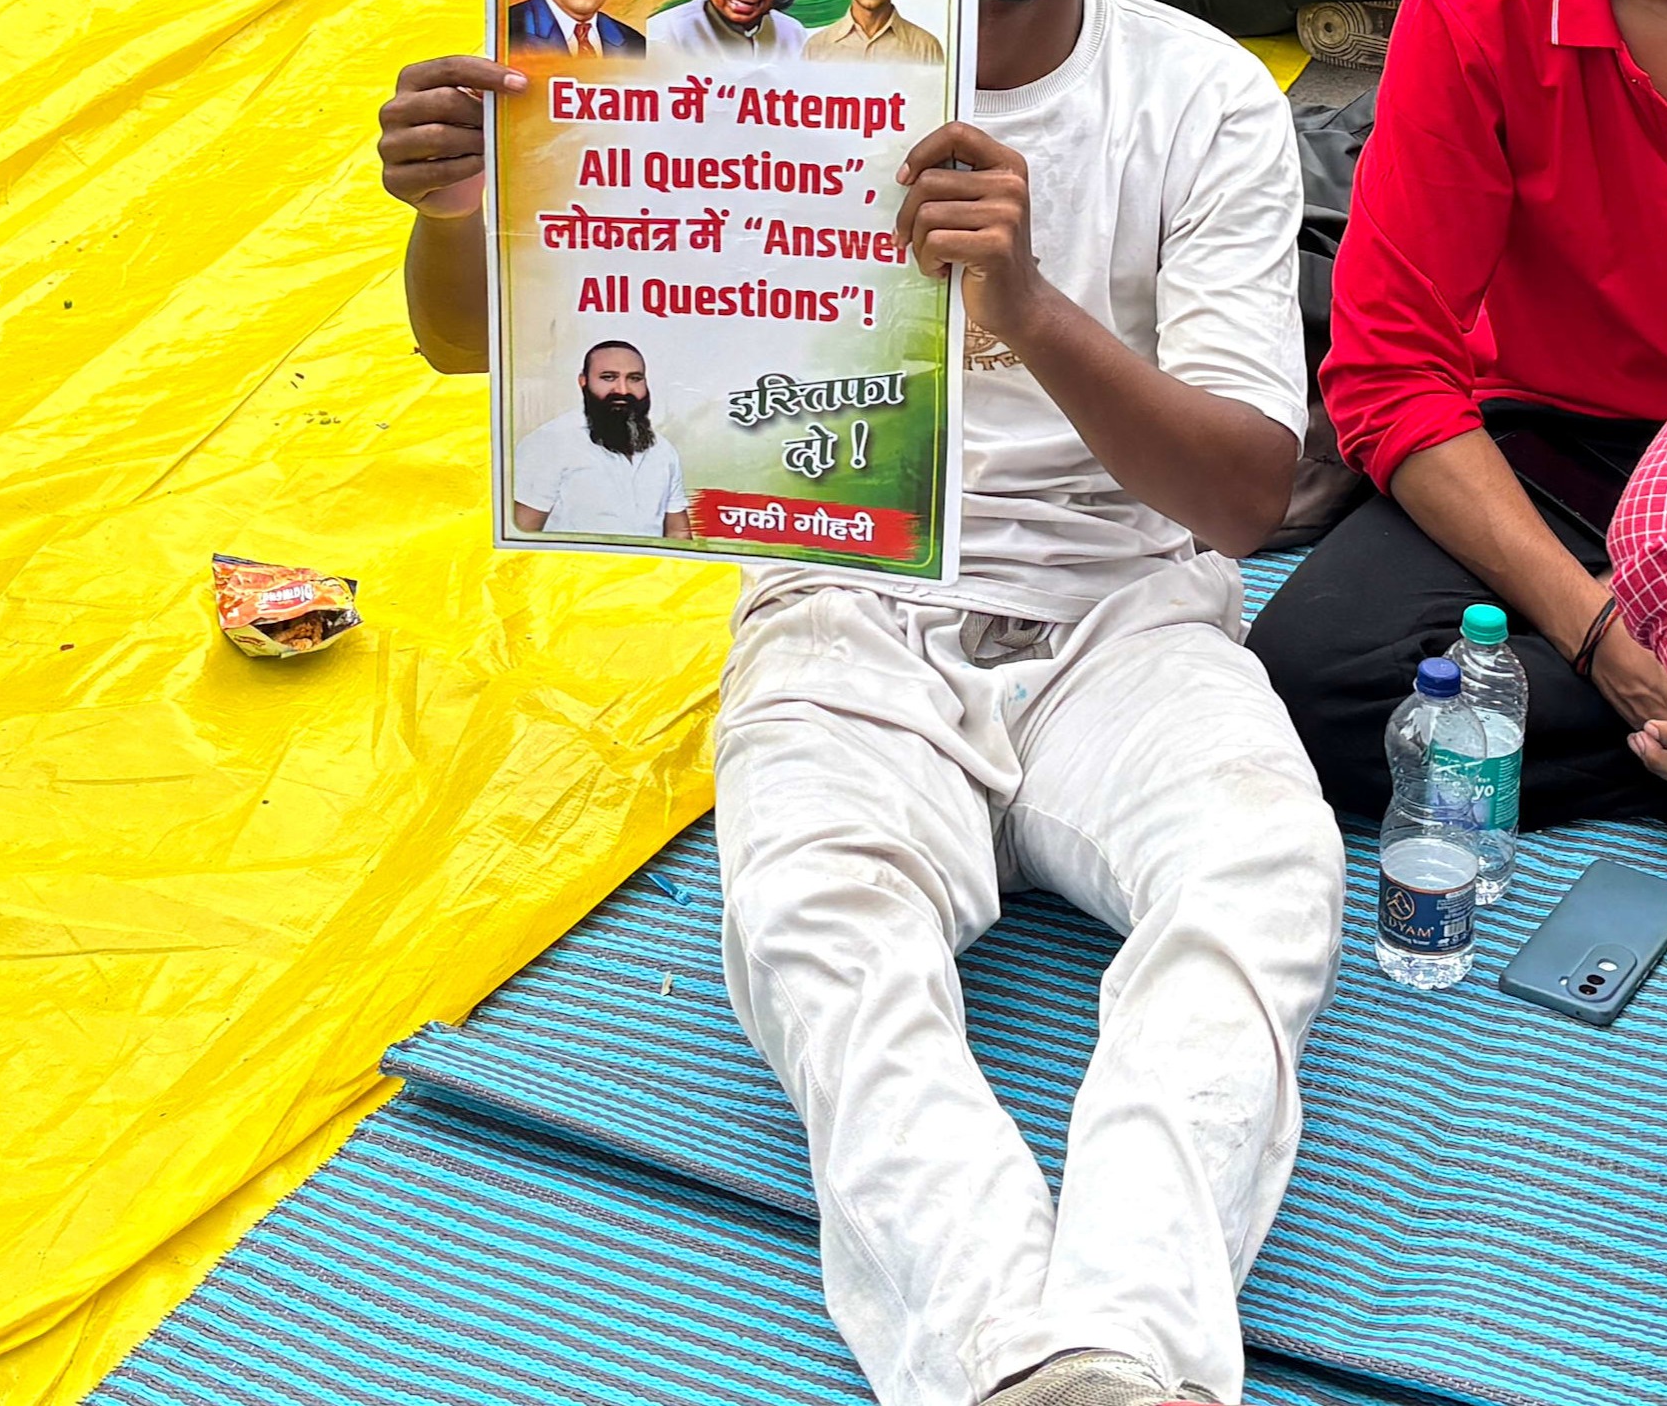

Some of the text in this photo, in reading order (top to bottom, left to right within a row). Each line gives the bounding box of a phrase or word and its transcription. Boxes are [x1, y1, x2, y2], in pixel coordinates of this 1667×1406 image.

[552, 75, 905, 138] Exam में “Attempt
[579, 148, 631, 187] All
[539, 204, 680, 252] लोकतंत्र
[686, 207, 730, 253] में
[578, 275, 629, 313] All
[728, 373, 905, 424] इस्तिफा
[784, 424, 836, 476] दो
[717, 503, 875, 541] ज़की गौहरी
